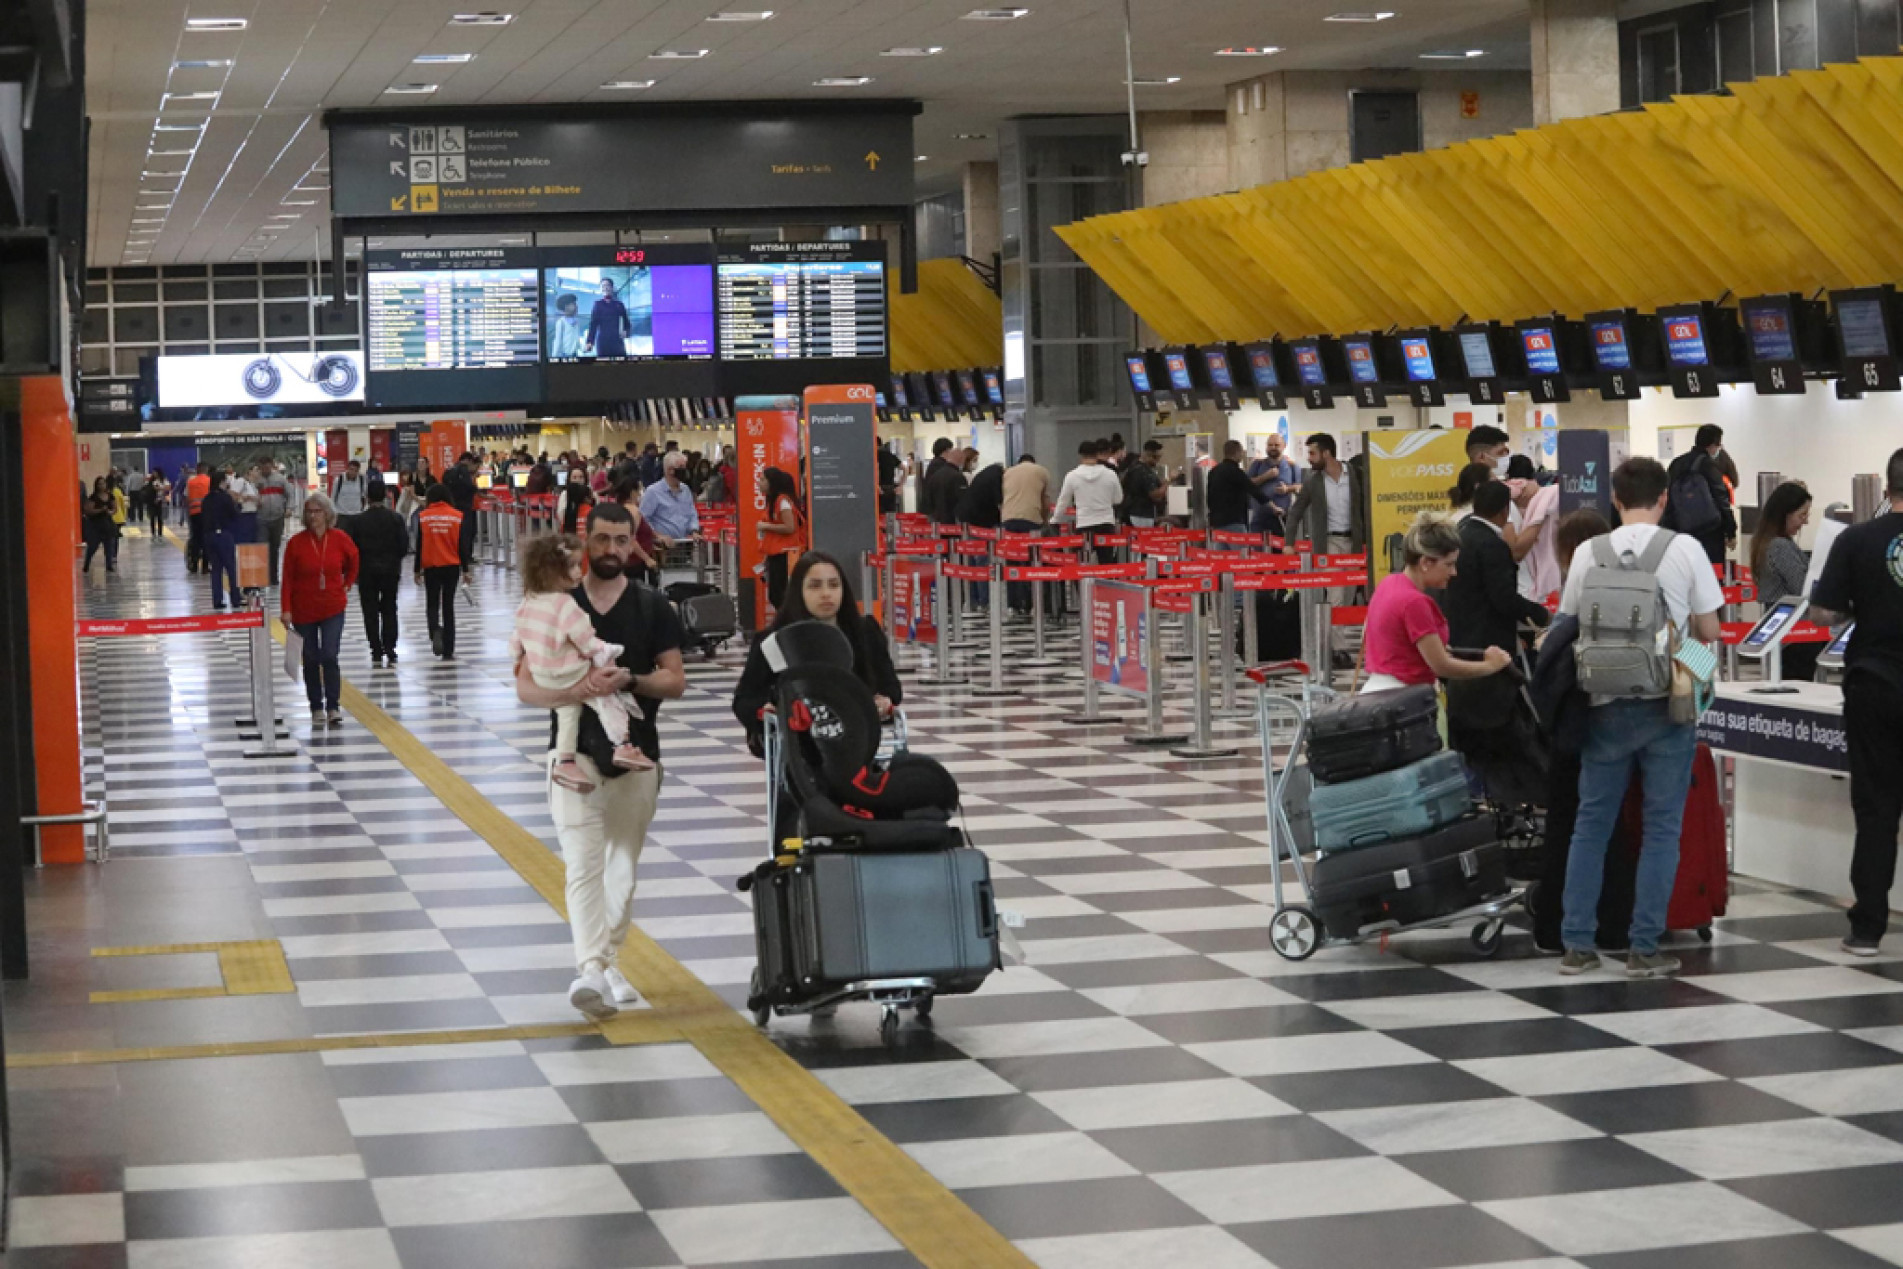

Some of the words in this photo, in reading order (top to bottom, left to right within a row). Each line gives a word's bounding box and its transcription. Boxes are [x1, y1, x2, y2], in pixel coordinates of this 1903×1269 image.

[468, 129, 519, 139] Sanitários
[469, 159, 511, 167] Telefone
[513, 156, 551, 166] Público
[771, 164, 803, 174] Tarifas
[442, 187, 475, 197] Venda
[487, 187, 525, 196] reserva
[528, 185, 541, 194] de
[544, 185, 581, 195] Bilhete
[750, 244, 791, 252] PARTIDAS
[797, 243, 851, 251] DEPARTURES
[401, 251, 442, 259] PARTIDAS
[450, 250, 504, 258] DEPARTURES
[847, 387, 872, 399] GOL
[811, 413, 855, 425] Premium
[1377, 490, 1426, 502] DIMENSÕES
[1727, 712, 1747, 730] sua
[1748, 714, 1792, 740] etiqueta
[1795, 719, 1809, 741] de
